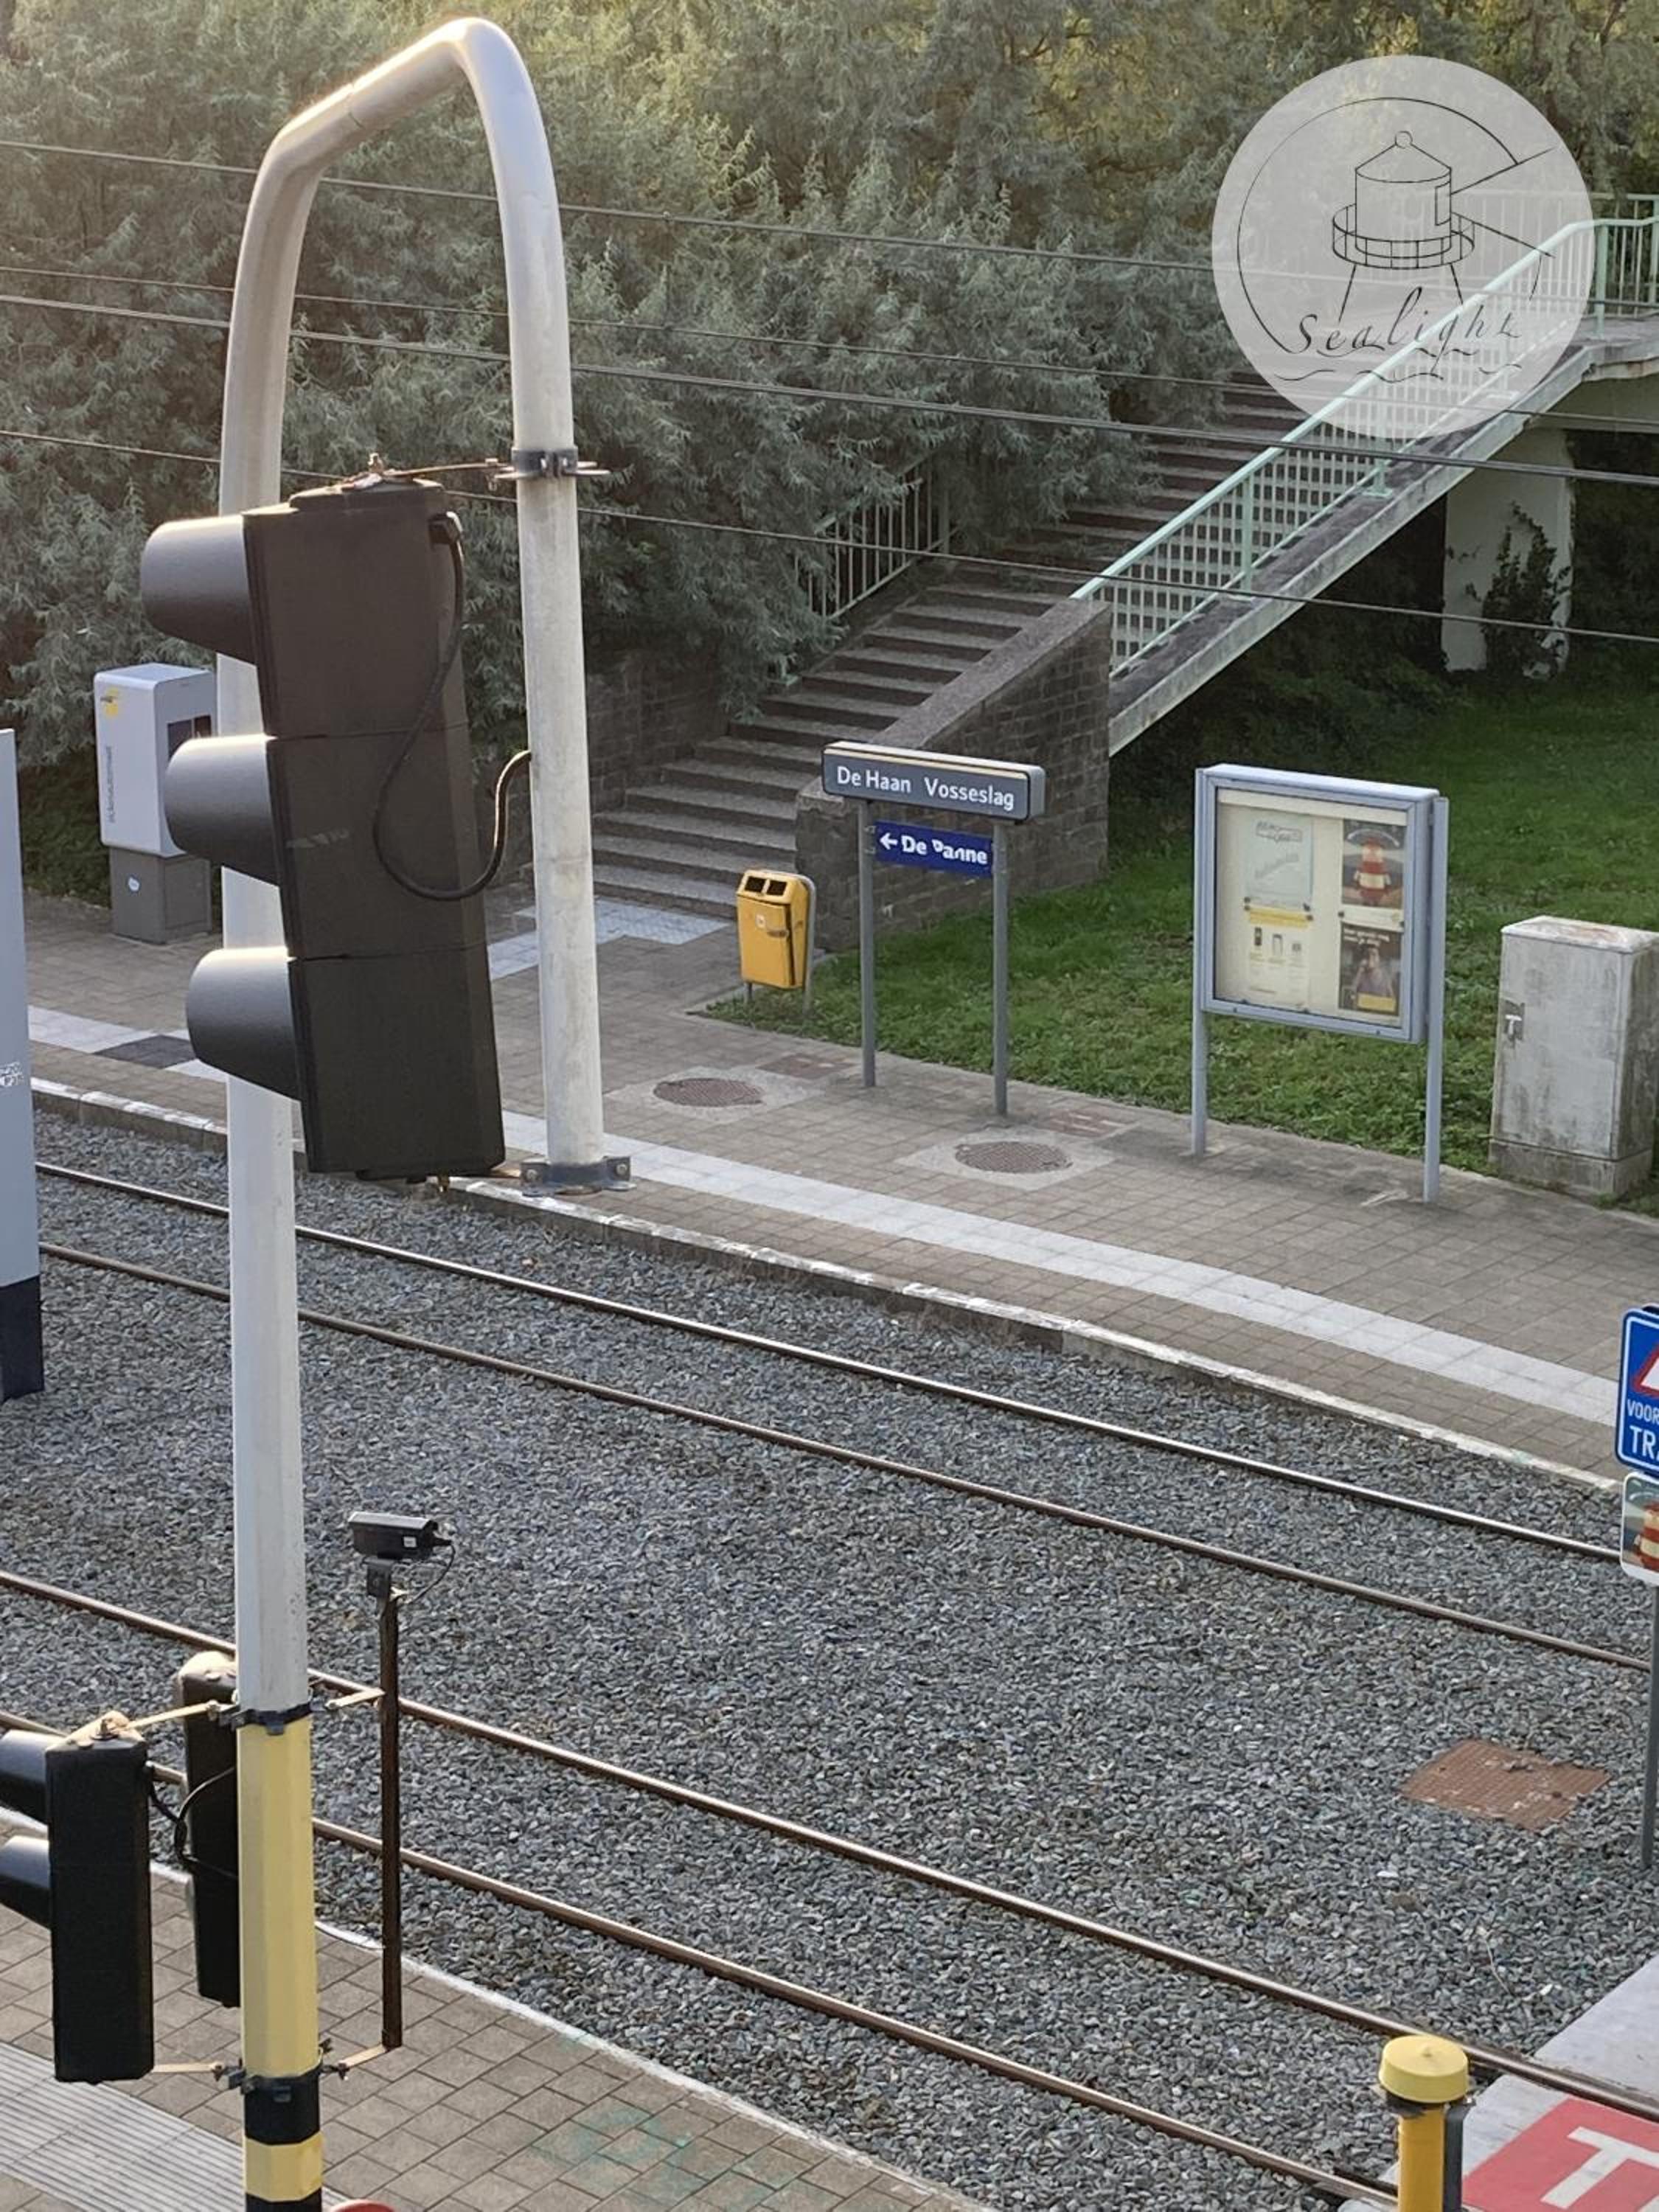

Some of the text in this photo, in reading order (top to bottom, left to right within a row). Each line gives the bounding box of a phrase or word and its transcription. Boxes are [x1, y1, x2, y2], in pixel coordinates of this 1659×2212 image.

[837, 766, 1015, 811] De Haan Vosseslag
[901, 835, 928, 855] De
[1630, 1425, 1659, 1461] TR
